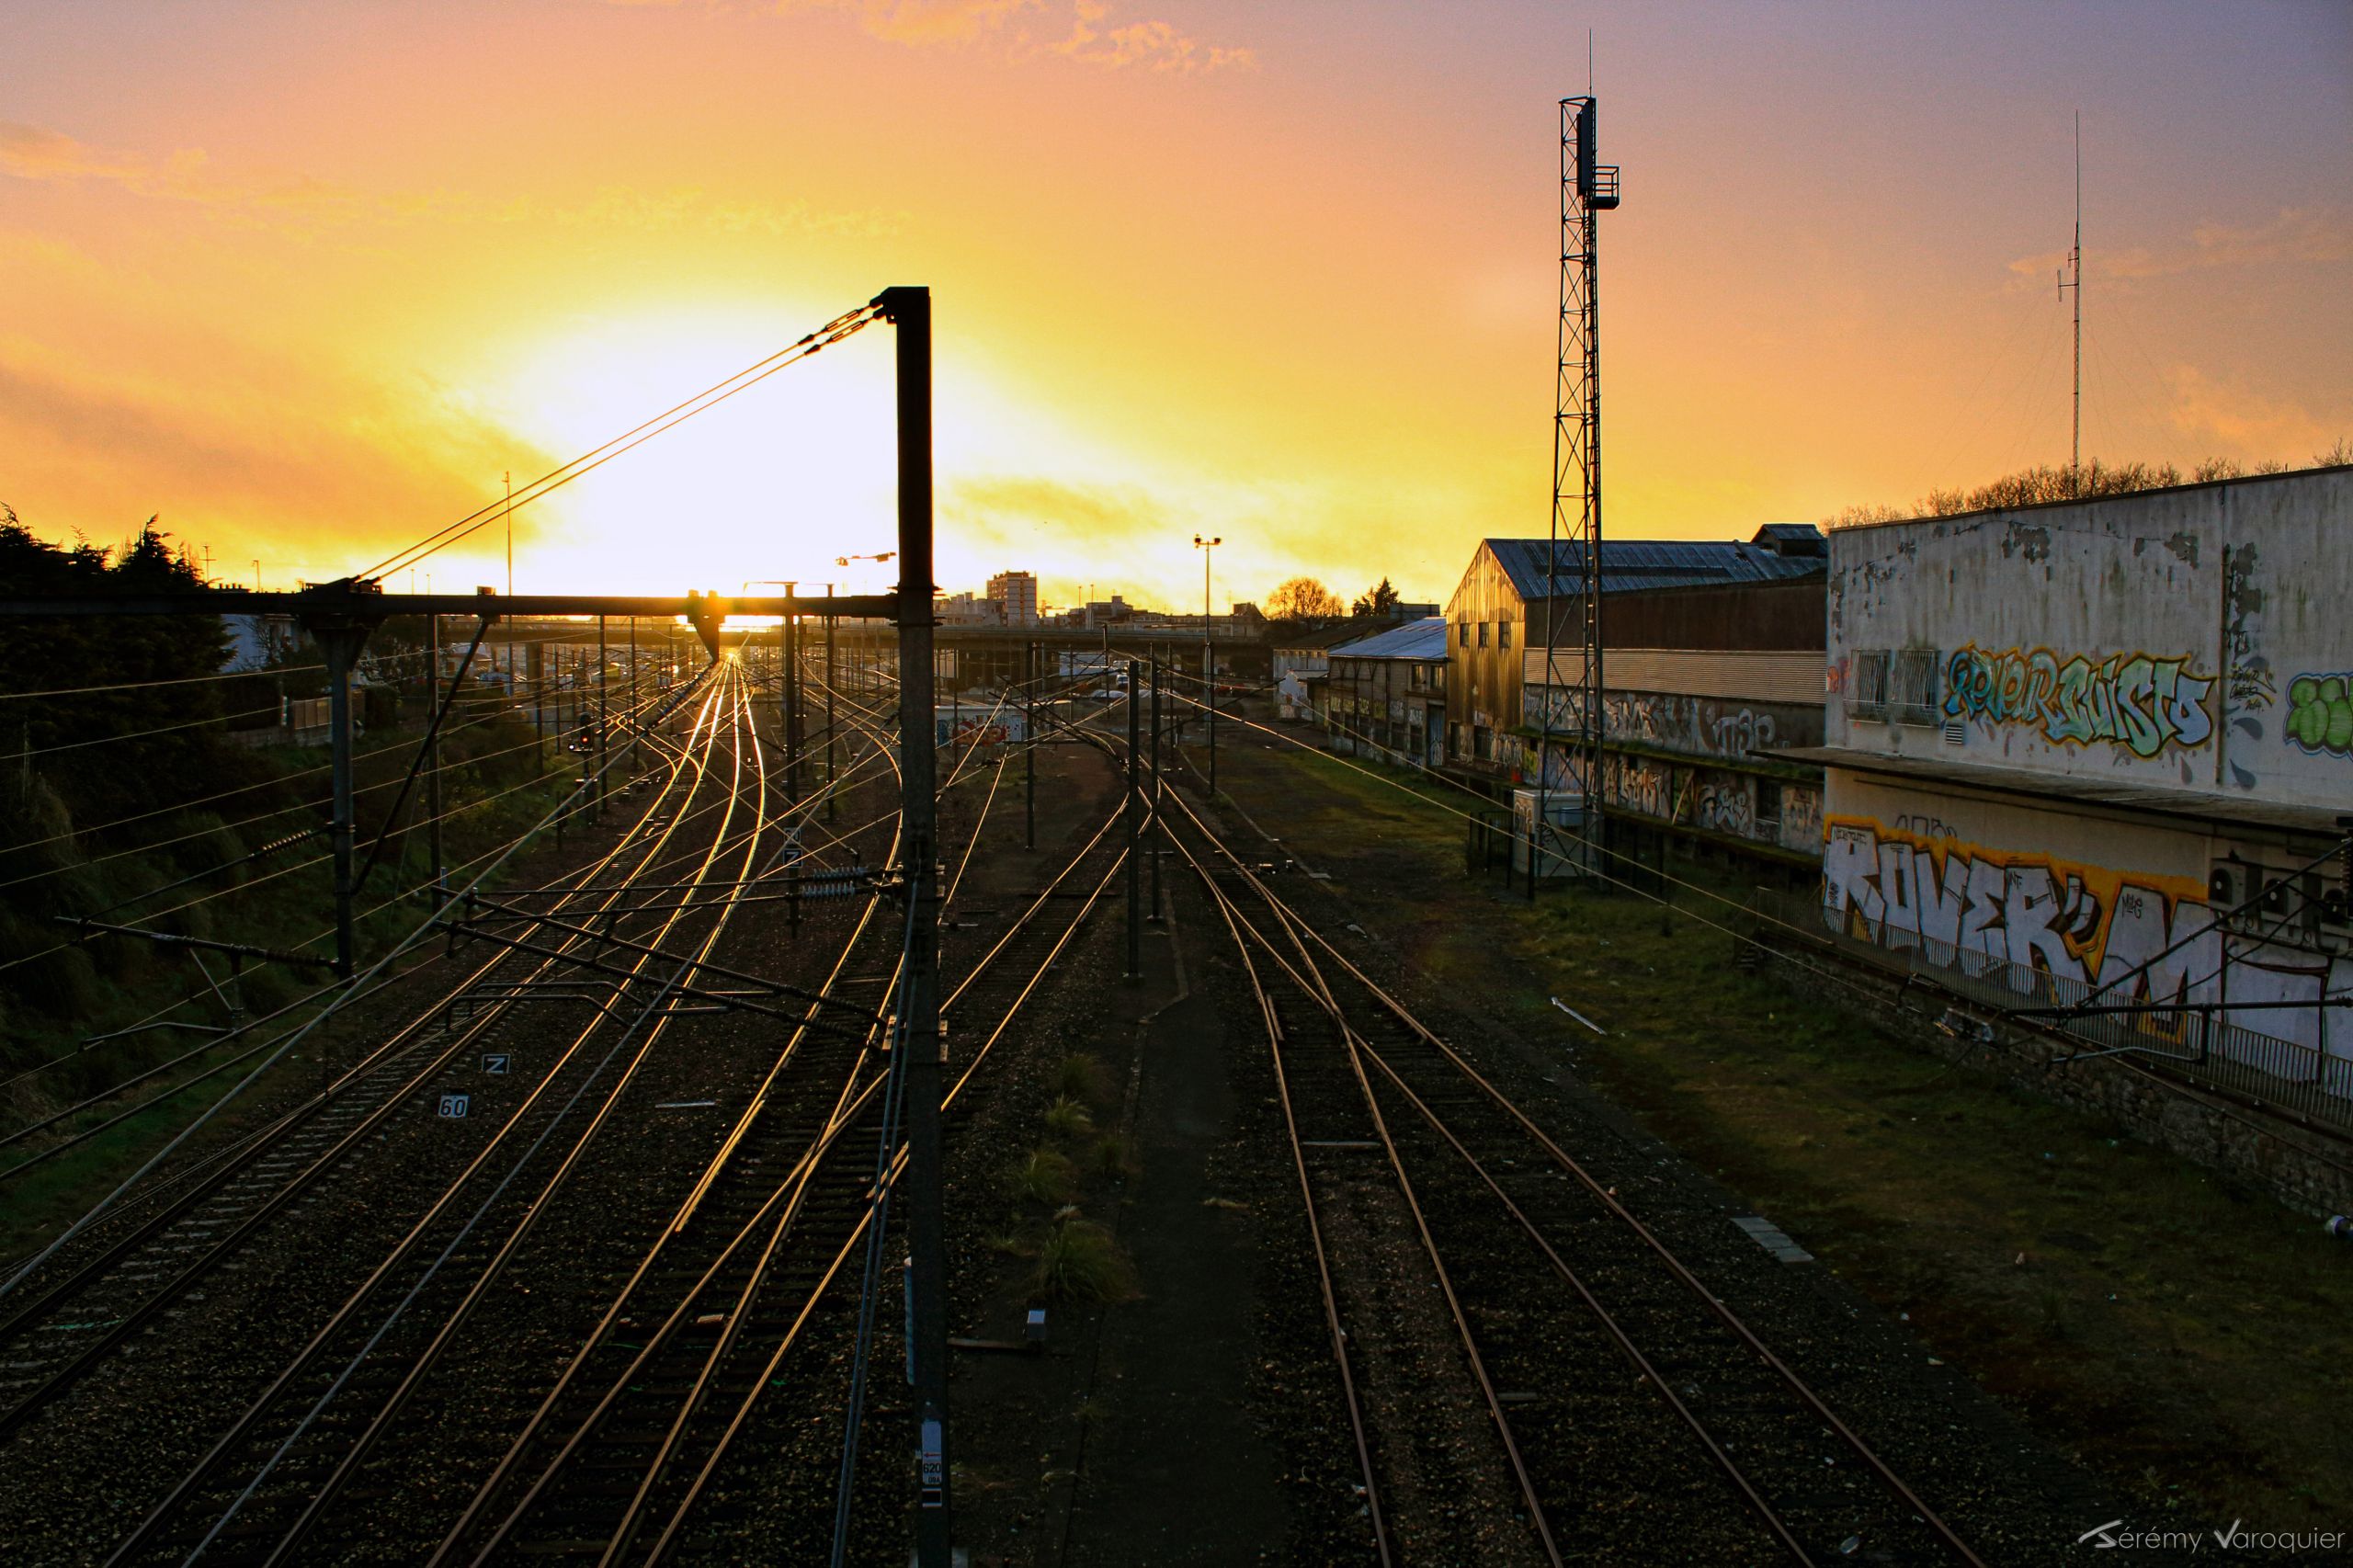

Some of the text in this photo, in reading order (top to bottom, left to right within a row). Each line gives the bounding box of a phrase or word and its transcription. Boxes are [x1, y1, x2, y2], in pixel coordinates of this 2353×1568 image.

[485, 1057, 506, 1074] Z
[440, 1099, 465, 1116] 60
[924, 1462, 941, 1473] 620
